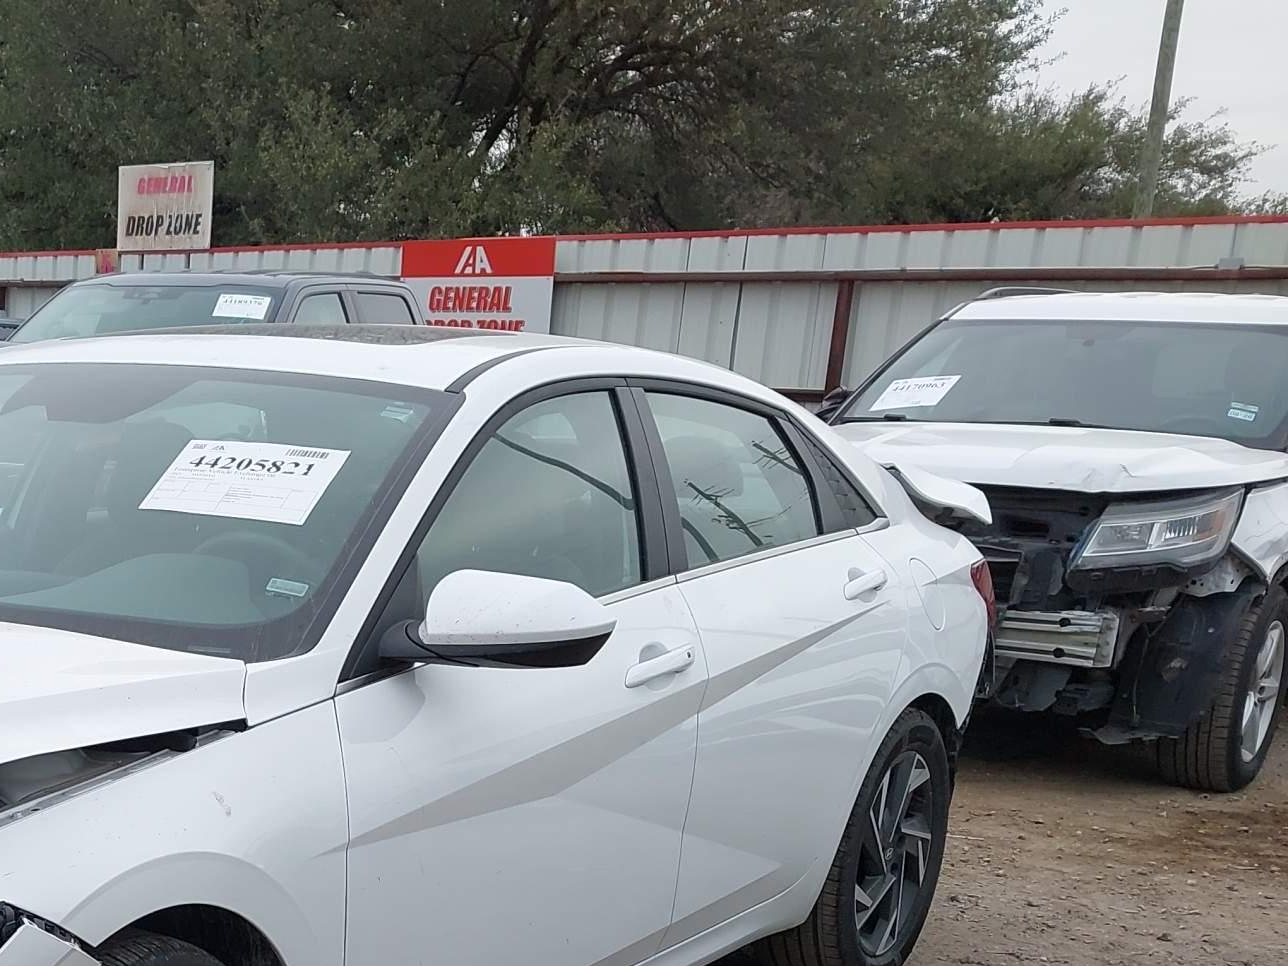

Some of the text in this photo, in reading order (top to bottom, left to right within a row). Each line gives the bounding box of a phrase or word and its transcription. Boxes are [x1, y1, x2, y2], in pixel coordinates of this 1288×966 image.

[137, 175, 193, 195] GENERAL
[126, 213, 202, 237] DROP ZONE
[428, 286, 512, 313] GENERAL
[189, 455, 315, 476] 44205821
